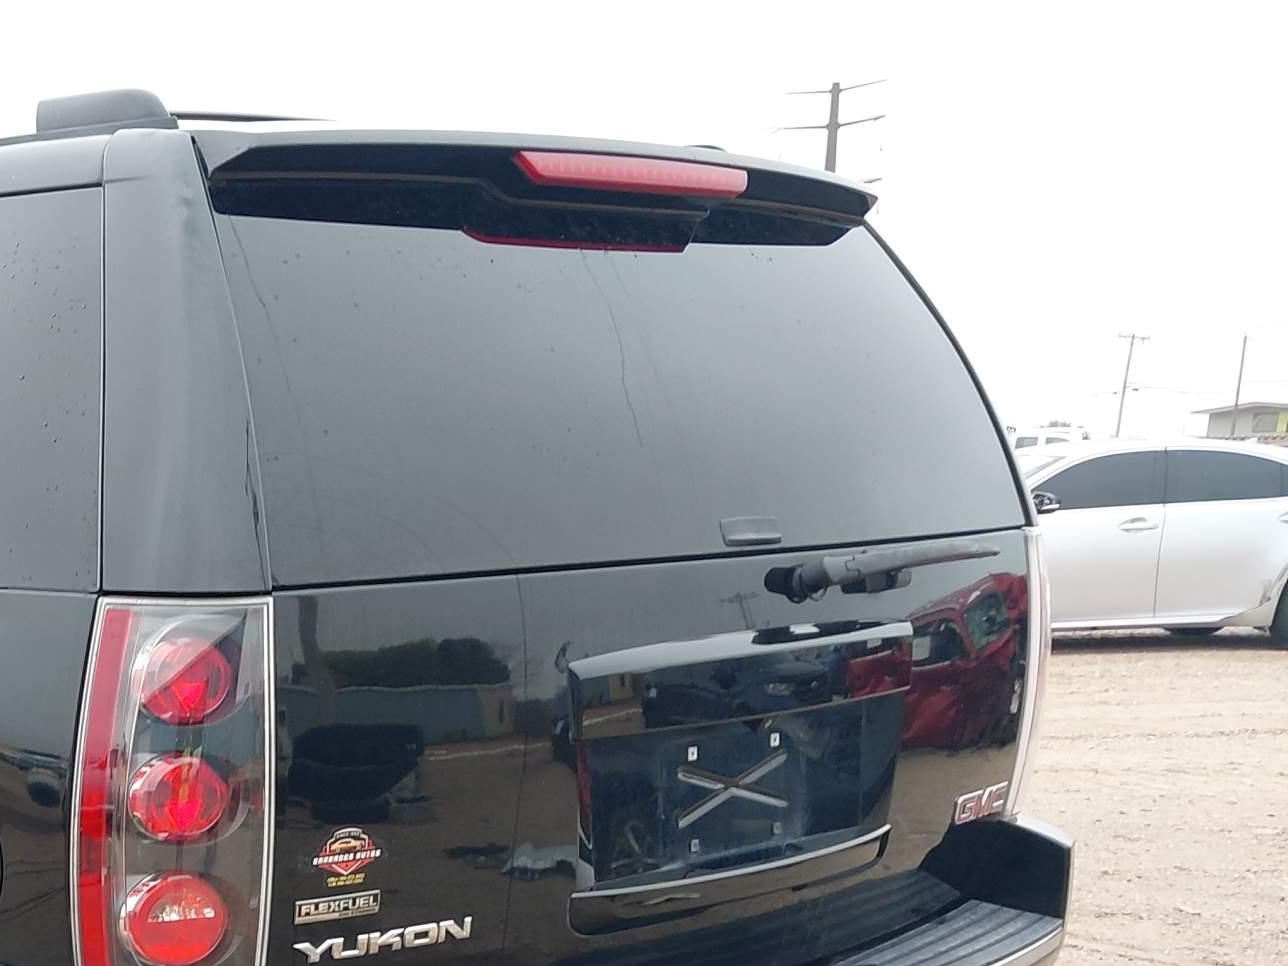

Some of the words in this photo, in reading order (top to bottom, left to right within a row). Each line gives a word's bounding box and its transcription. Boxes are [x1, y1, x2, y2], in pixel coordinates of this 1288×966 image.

[955, 781, 1009, 825] GMC
[300, 895, 378, 917] FLEXFUEL
[293, 916, 473, 964] YUKON
